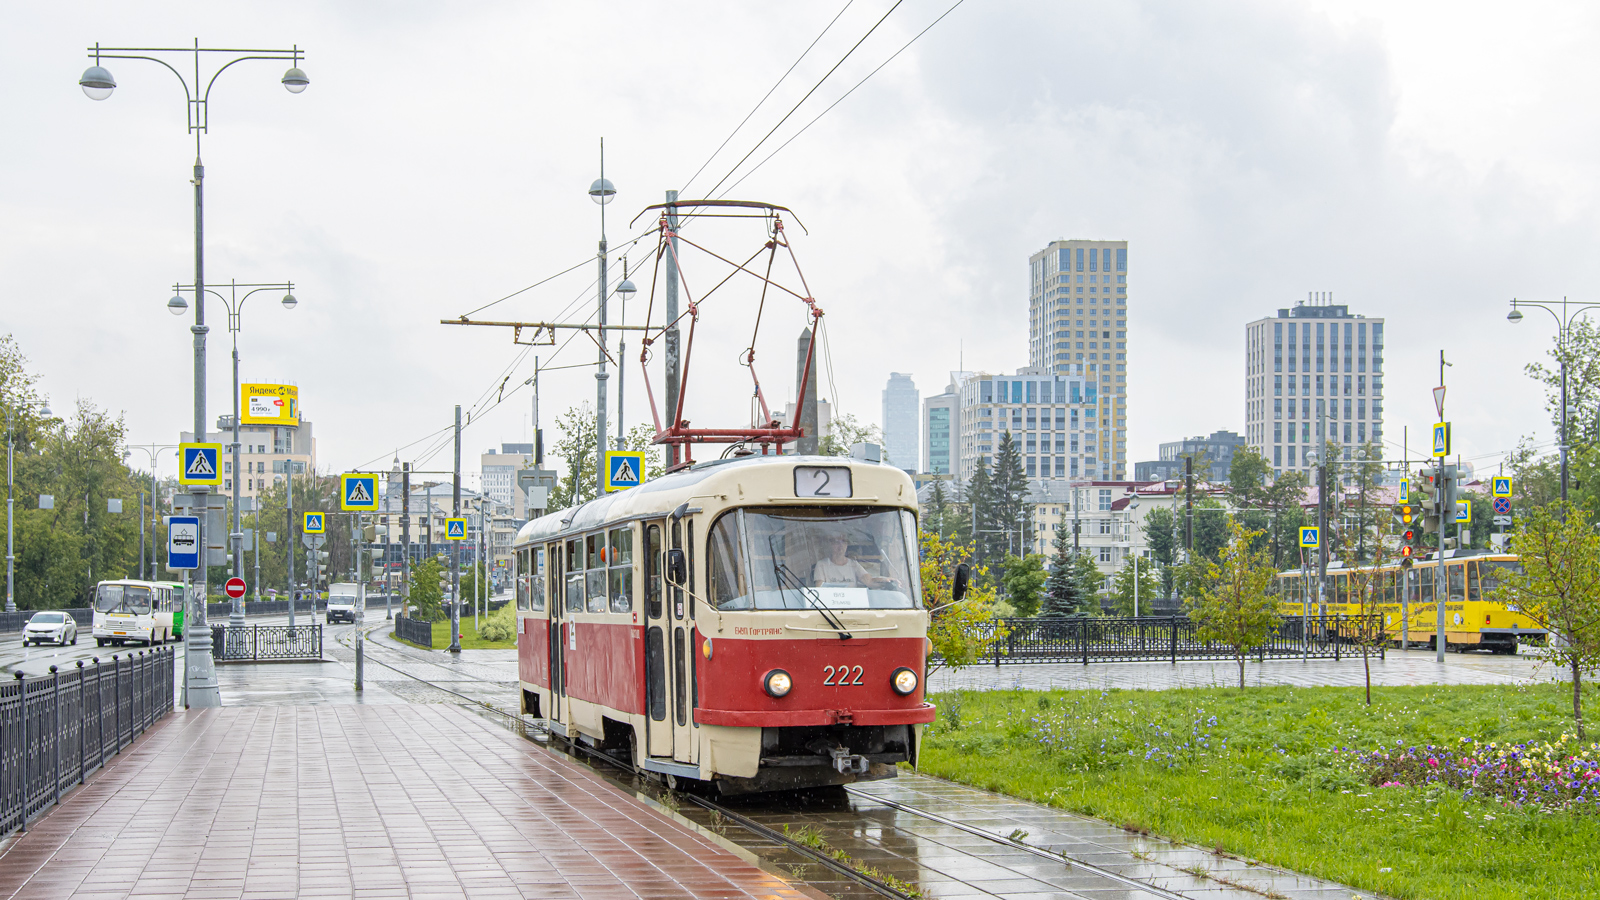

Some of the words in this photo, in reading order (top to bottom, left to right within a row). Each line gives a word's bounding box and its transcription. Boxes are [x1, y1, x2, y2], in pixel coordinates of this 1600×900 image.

[249, 386, 277, 395] Яндекс
[813, 469, 831, 496] 2
[569, 620, 575, 637] 2
[823, 665, 864, 686] 222
